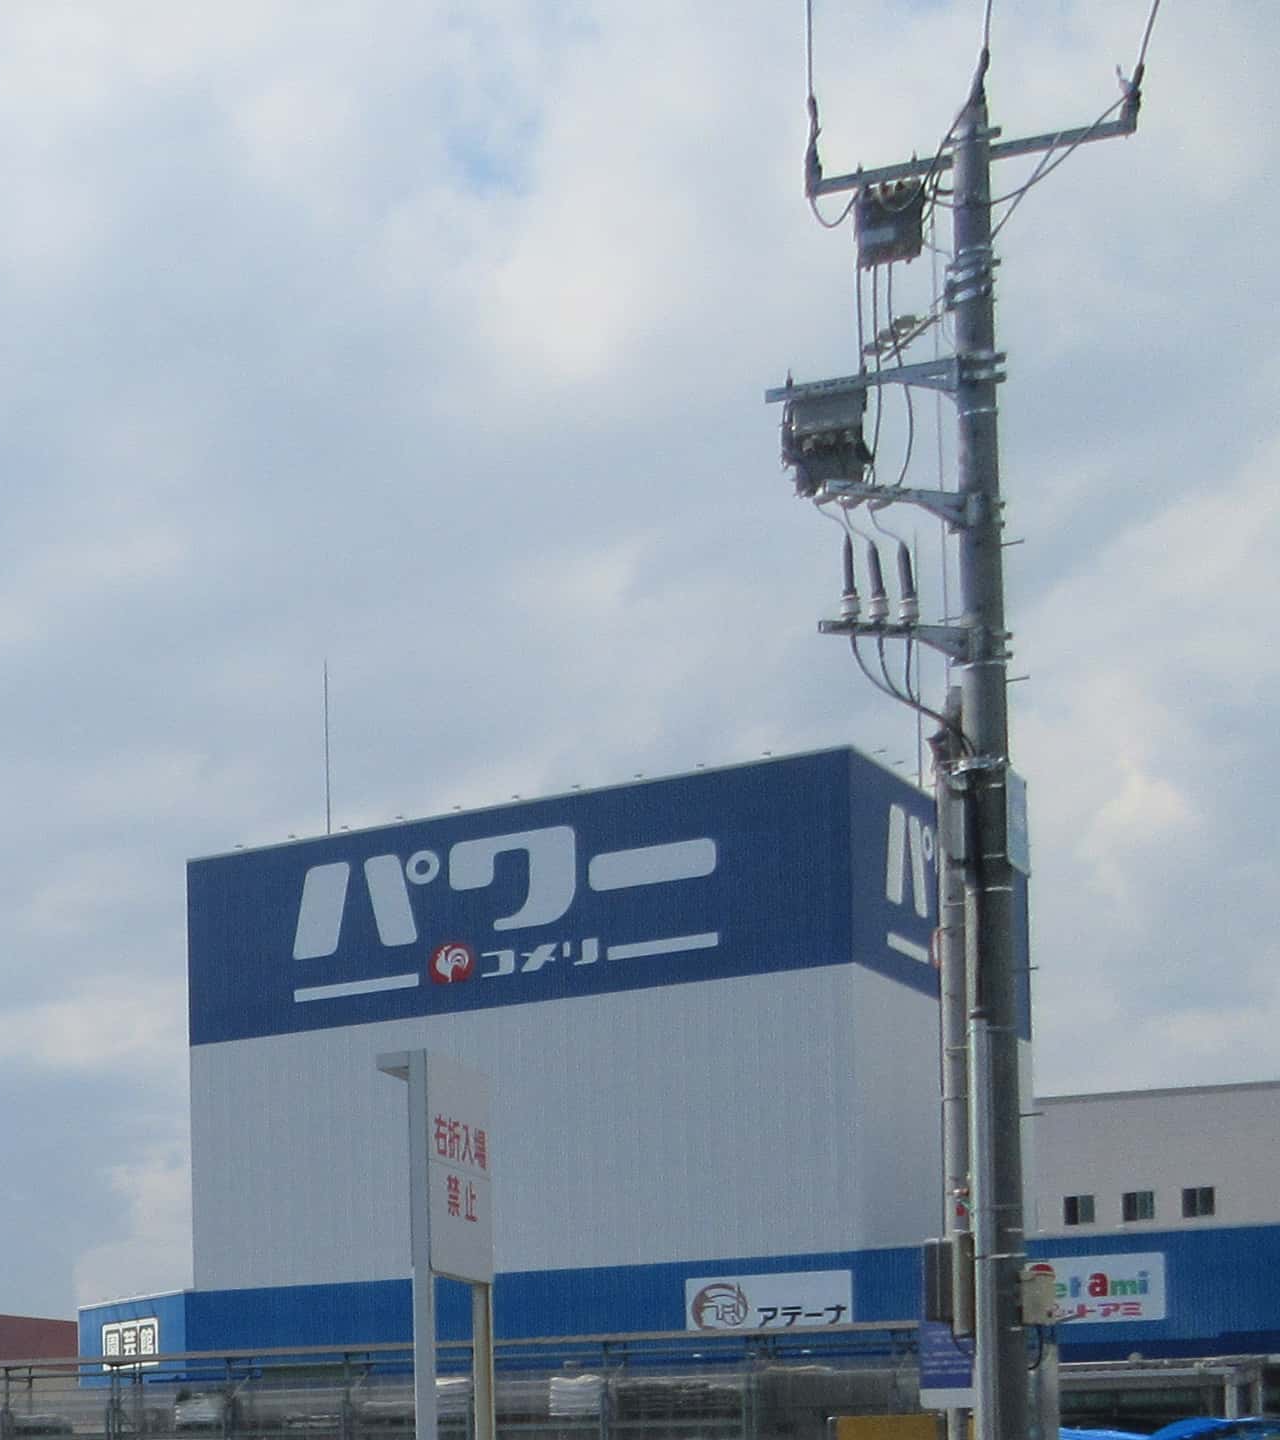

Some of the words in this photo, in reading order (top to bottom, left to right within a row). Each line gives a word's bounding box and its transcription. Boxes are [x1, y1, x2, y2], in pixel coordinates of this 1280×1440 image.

[292, 824, 718, 961] パワー
[480, 937, 599, 979] コメリ
[434, 1113, 487, 1171] 右折入場
[447, 1173, 479, 1223] 禁止
[756, 1303, 848, 1329] アテーナ
[1054, 1301, 1143, 1319] ットアミ
